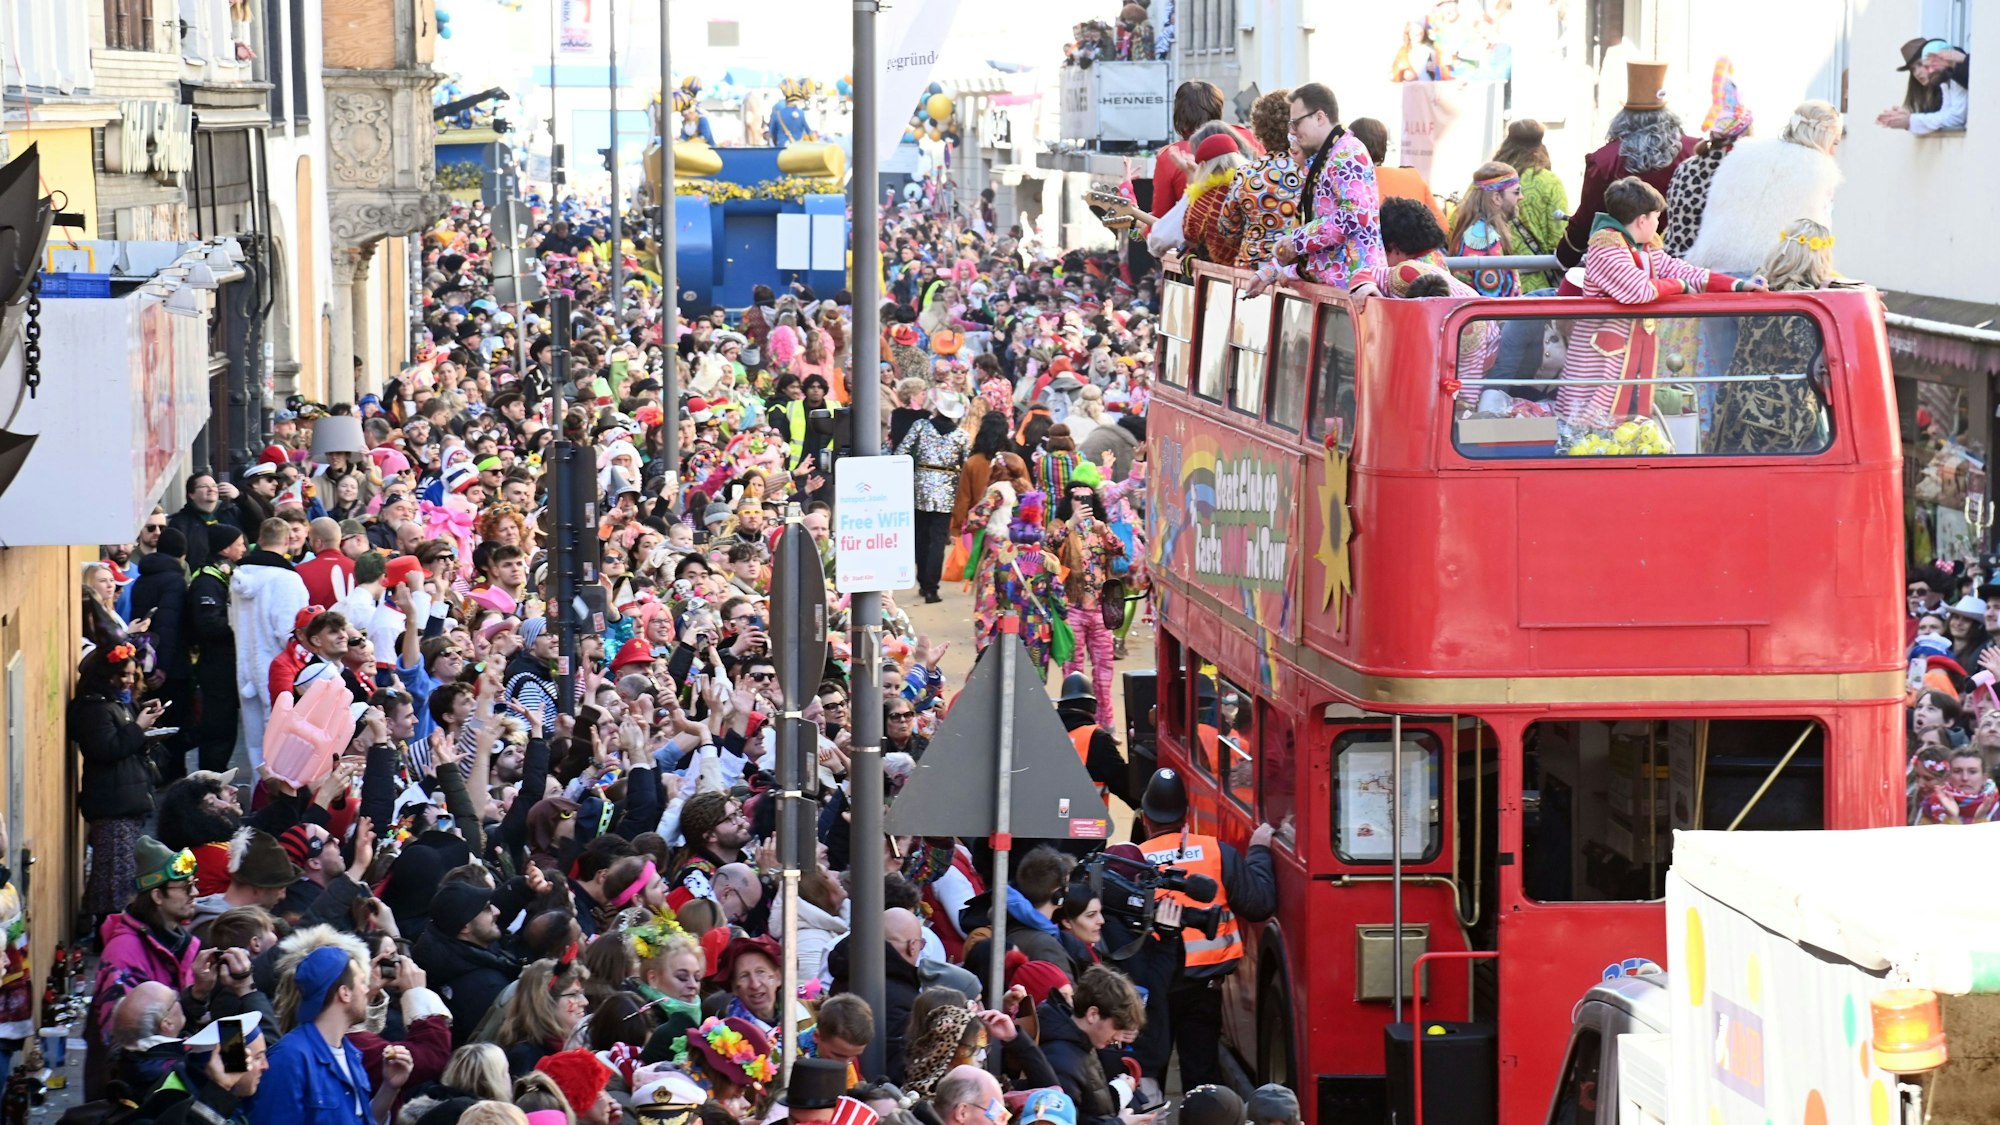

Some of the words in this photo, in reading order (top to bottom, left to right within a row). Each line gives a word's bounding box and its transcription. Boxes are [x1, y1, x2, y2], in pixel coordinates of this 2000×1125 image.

[886, 50, 939, 72] gegründ
[1102, 96, 1164, 105] HENNES
[1215, 459, 1239, 510] Beat
[1239, 457, 1262, 511] Club
[1264, 473, 1277, 529] op
[840, 514, 873, 530] Free
[877, 511, 911, 528] WiFi
[840, 535, 862, 551] für
[865, 532, 898, 550] alle!
[1260, 526, 1286, 581] Tour
[1146, 848, 1200, 862] Order
